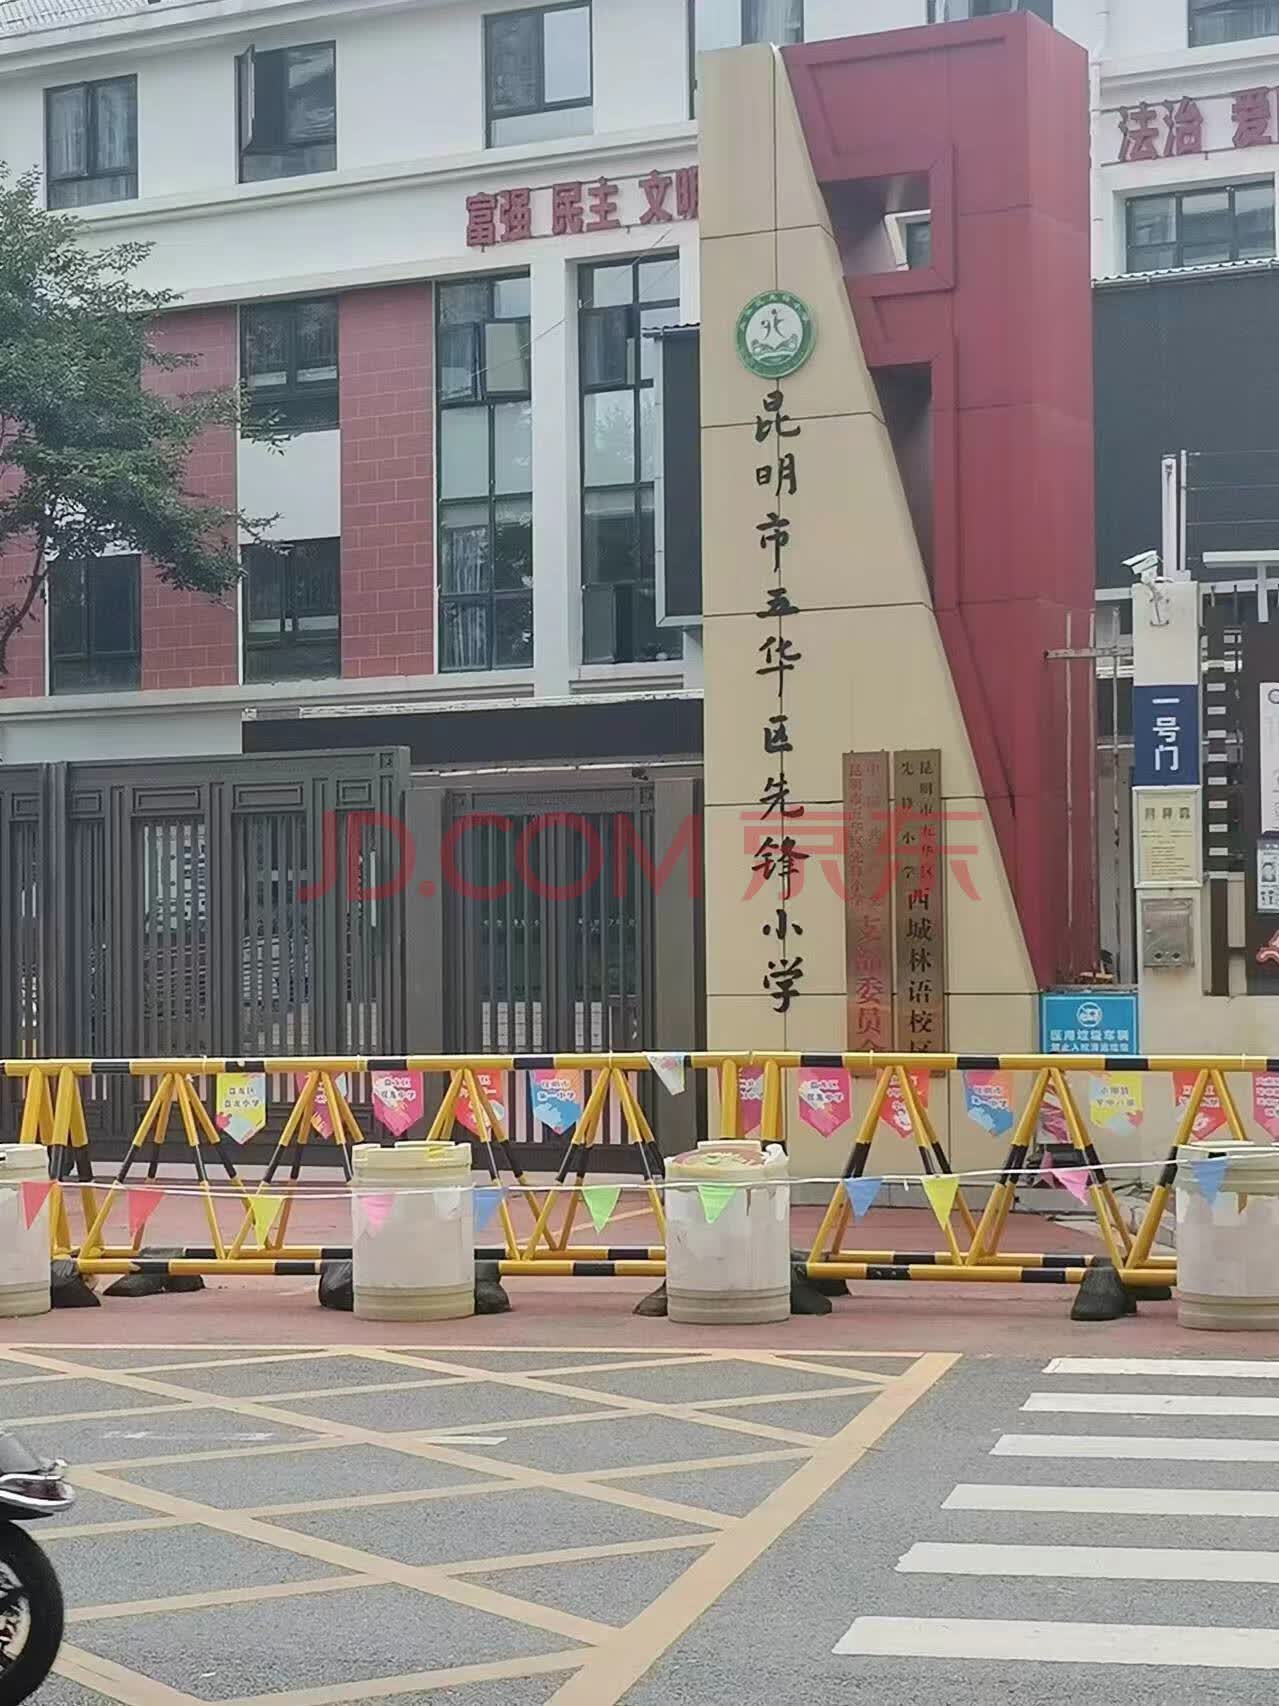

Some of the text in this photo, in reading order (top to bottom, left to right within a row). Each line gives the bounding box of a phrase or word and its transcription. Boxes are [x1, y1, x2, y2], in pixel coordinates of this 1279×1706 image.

[1118, 86, 1279, 162] 法治 爱
[466, 187, 531, 247] 富强
[552, 177, 621, 235] 民主
[752, 390, 810, 1013] 昆明市五华区先锋小学
[1152, 698, 1181, 771] 一号门
